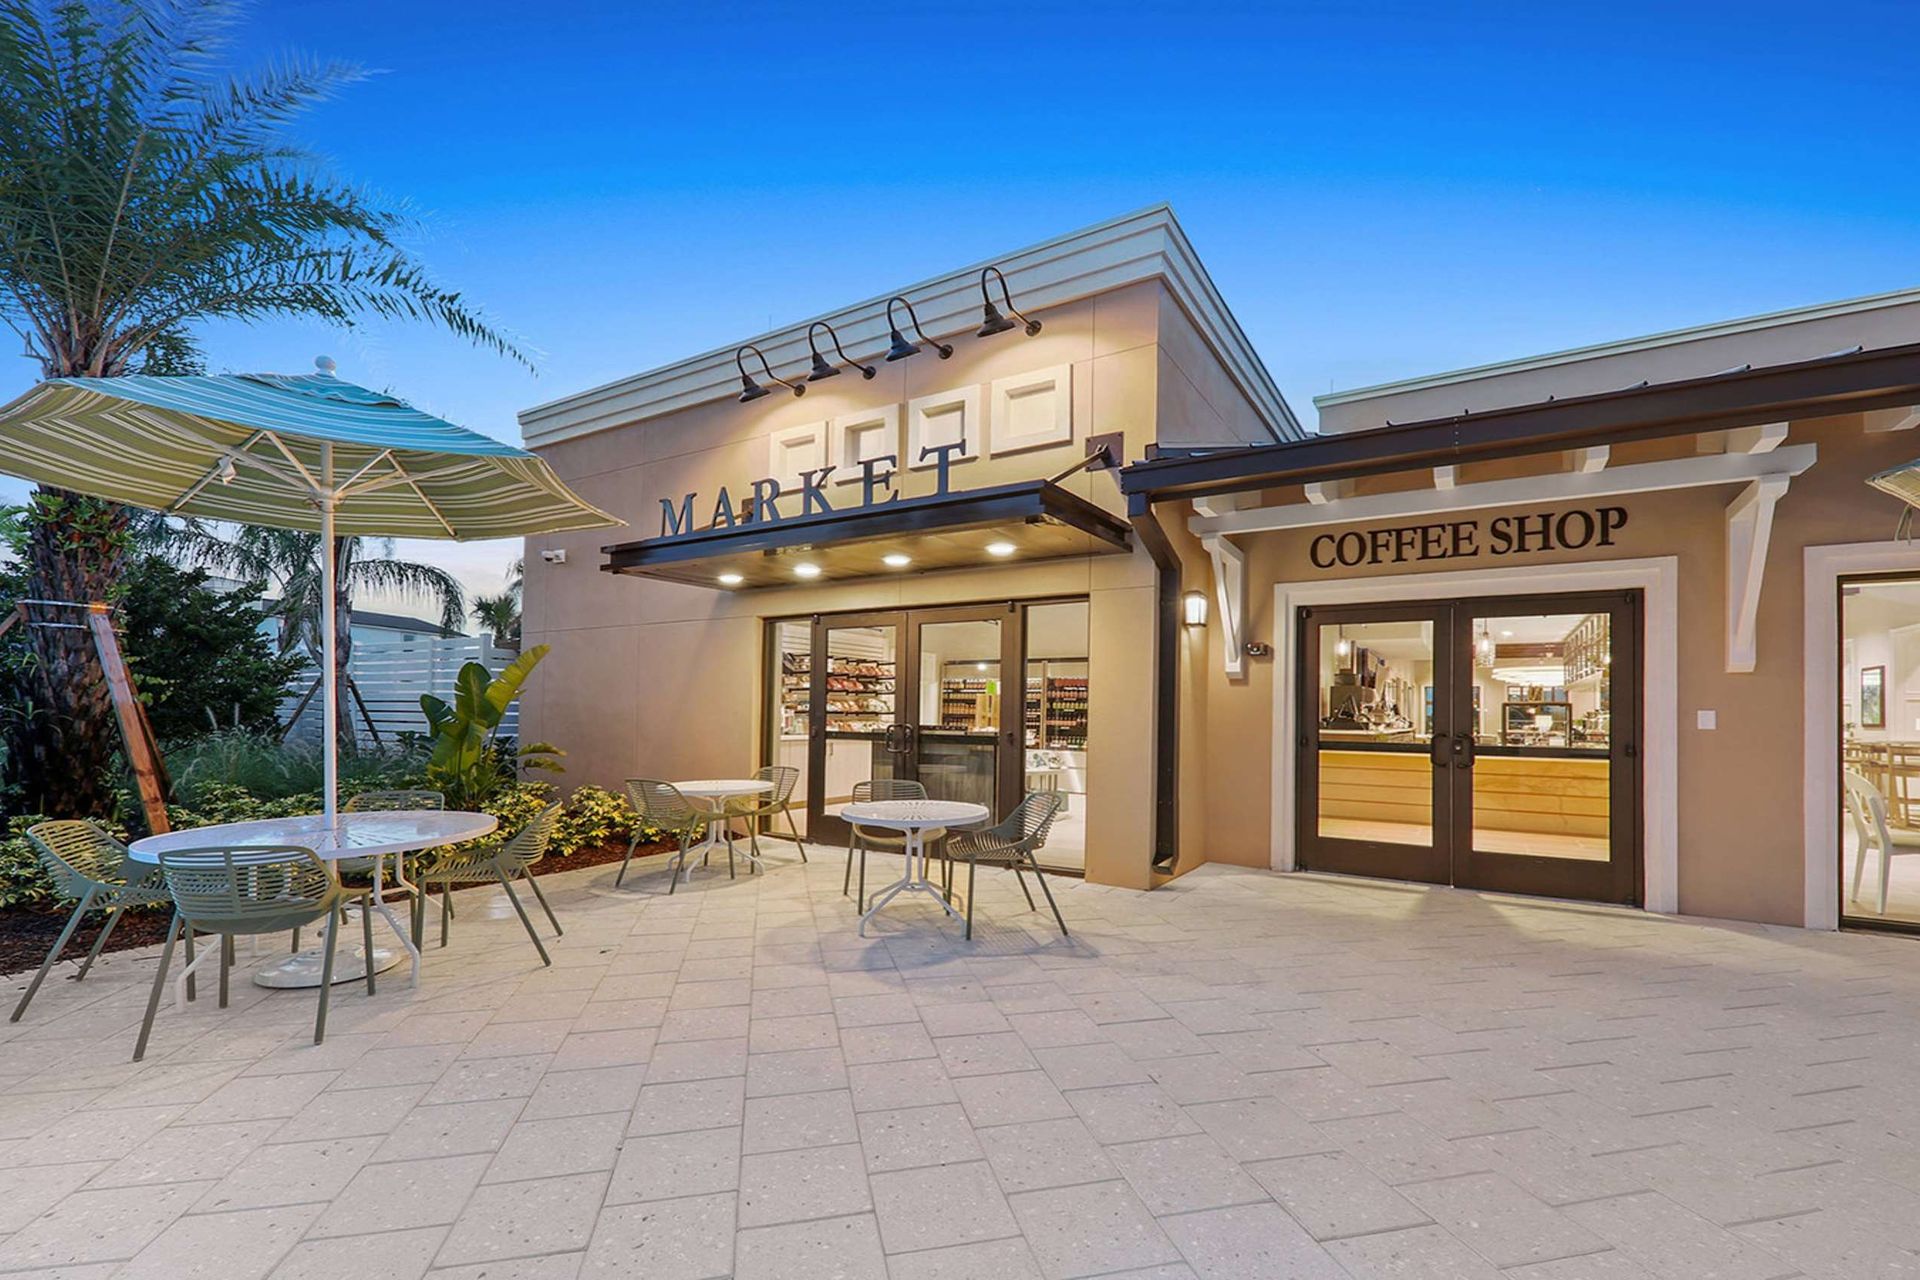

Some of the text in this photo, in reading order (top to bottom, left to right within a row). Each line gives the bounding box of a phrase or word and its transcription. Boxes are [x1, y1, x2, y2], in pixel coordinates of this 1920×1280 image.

[659, 438, 966, 538] MARKET
[1310, 506, 1628, 568] COFFEE SHOP
